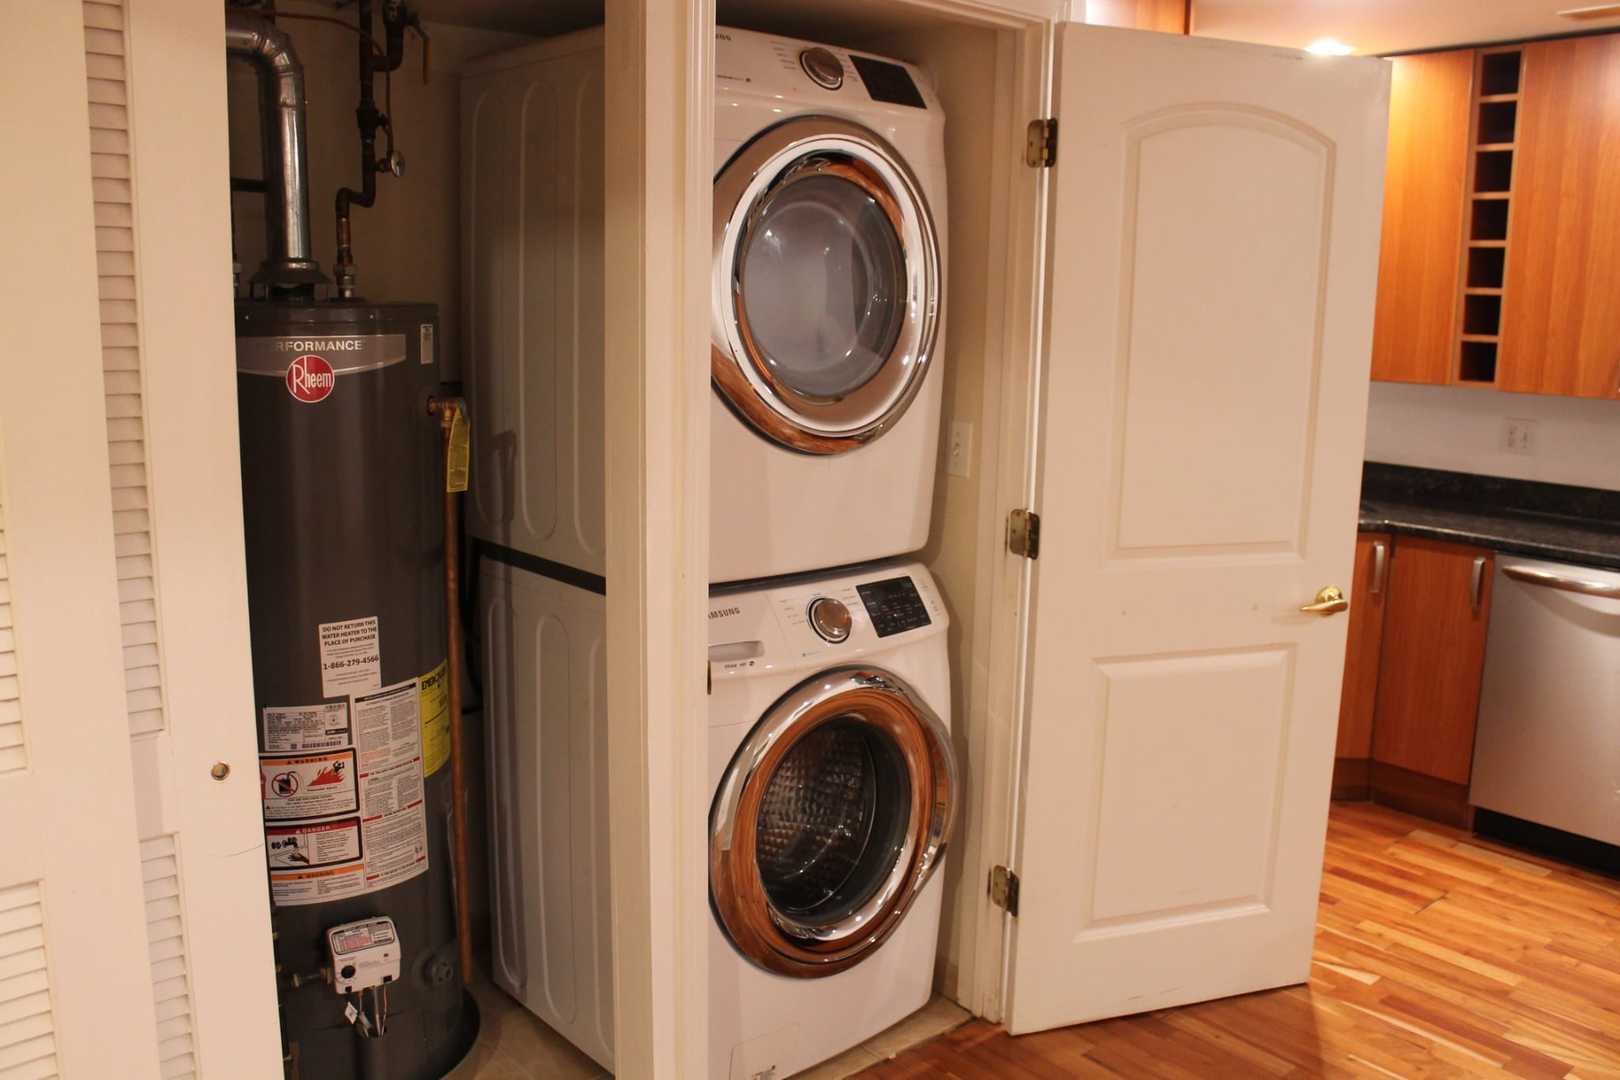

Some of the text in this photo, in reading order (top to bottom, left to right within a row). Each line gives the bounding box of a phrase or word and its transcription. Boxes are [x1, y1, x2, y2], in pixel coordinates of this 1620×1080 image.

[292, 355, 332, 394] Rheem
[344, 622, 364, 630] RETURN
[322, 632, 340, 640] WATER
[341, 629, 360, 637] HEATER
[324, 639, 341, 647] PLACE
[350, 634, 376, 643] PURCHASE
[323, 654, 379, 670] 1-866-279-4566
